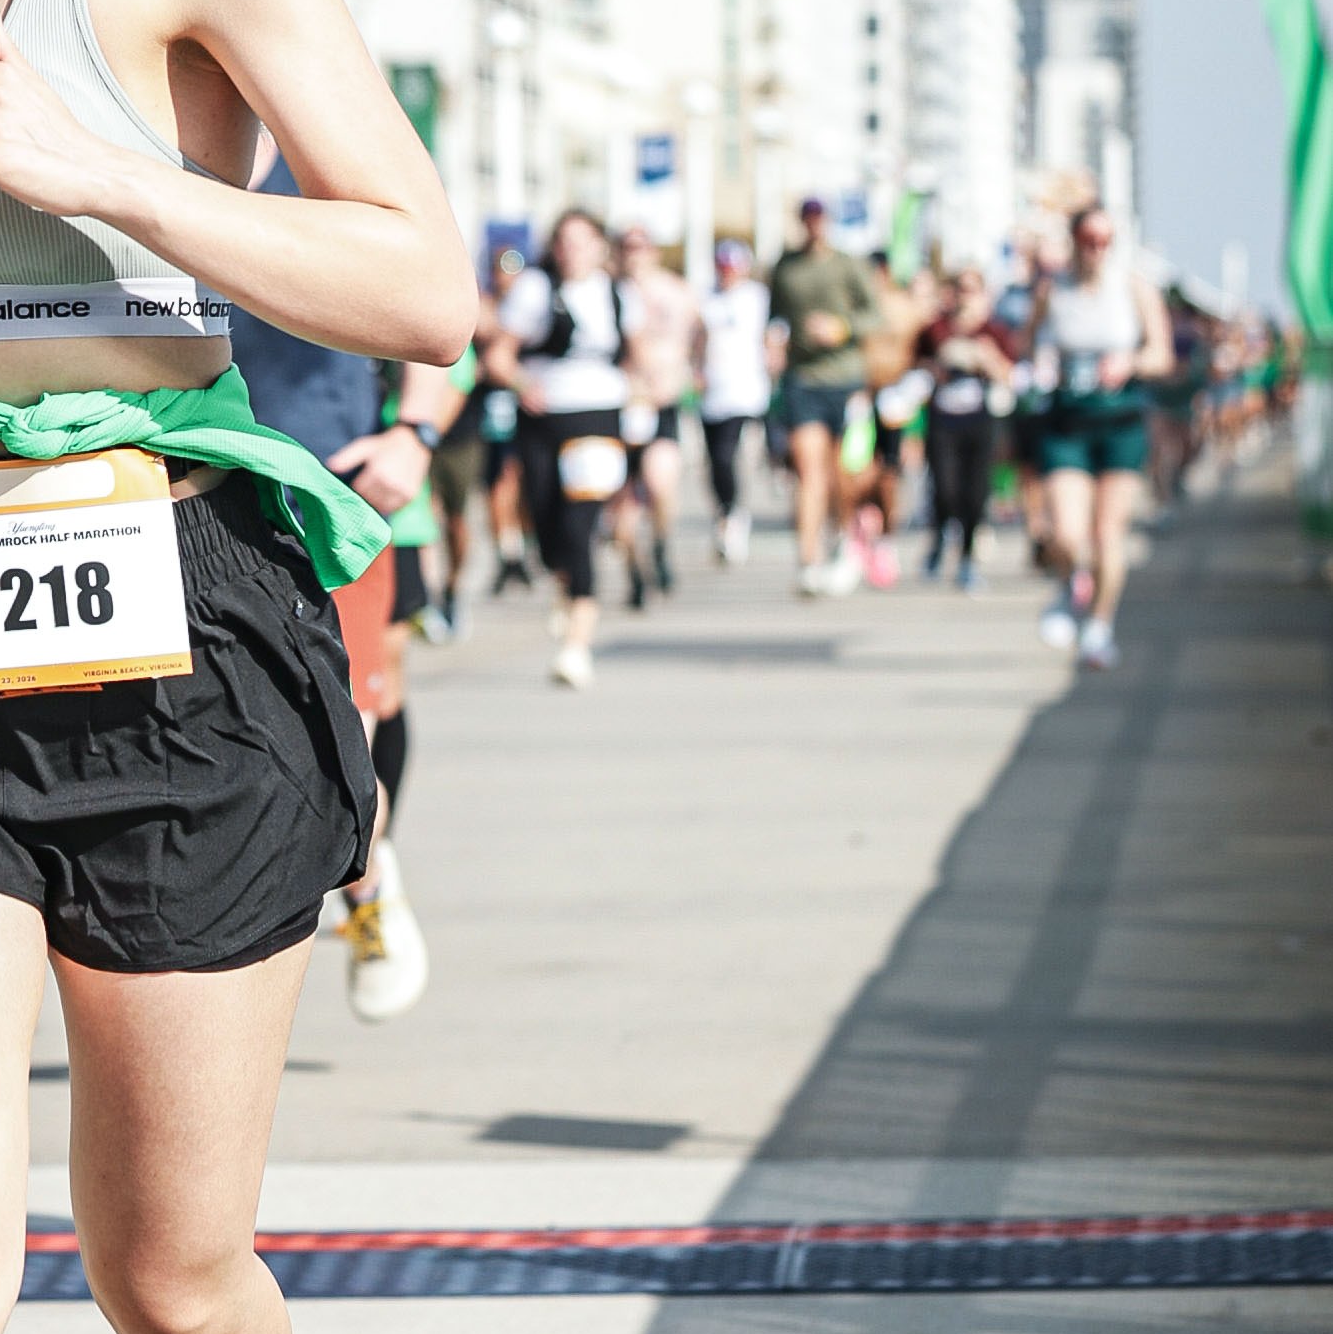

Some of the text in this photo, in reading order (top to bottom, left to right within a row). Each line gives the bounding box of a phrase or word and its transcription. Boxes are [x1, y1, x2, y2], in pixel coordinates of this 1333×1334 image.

[125, 299, 175, 317] new
[40, 532, 70, 543] HALF
[73, 526, 141, 541] MARATHON
[83, 669, 117, 677] VIRGINIA
[149, 663, 183, 671] VIRGINIA
